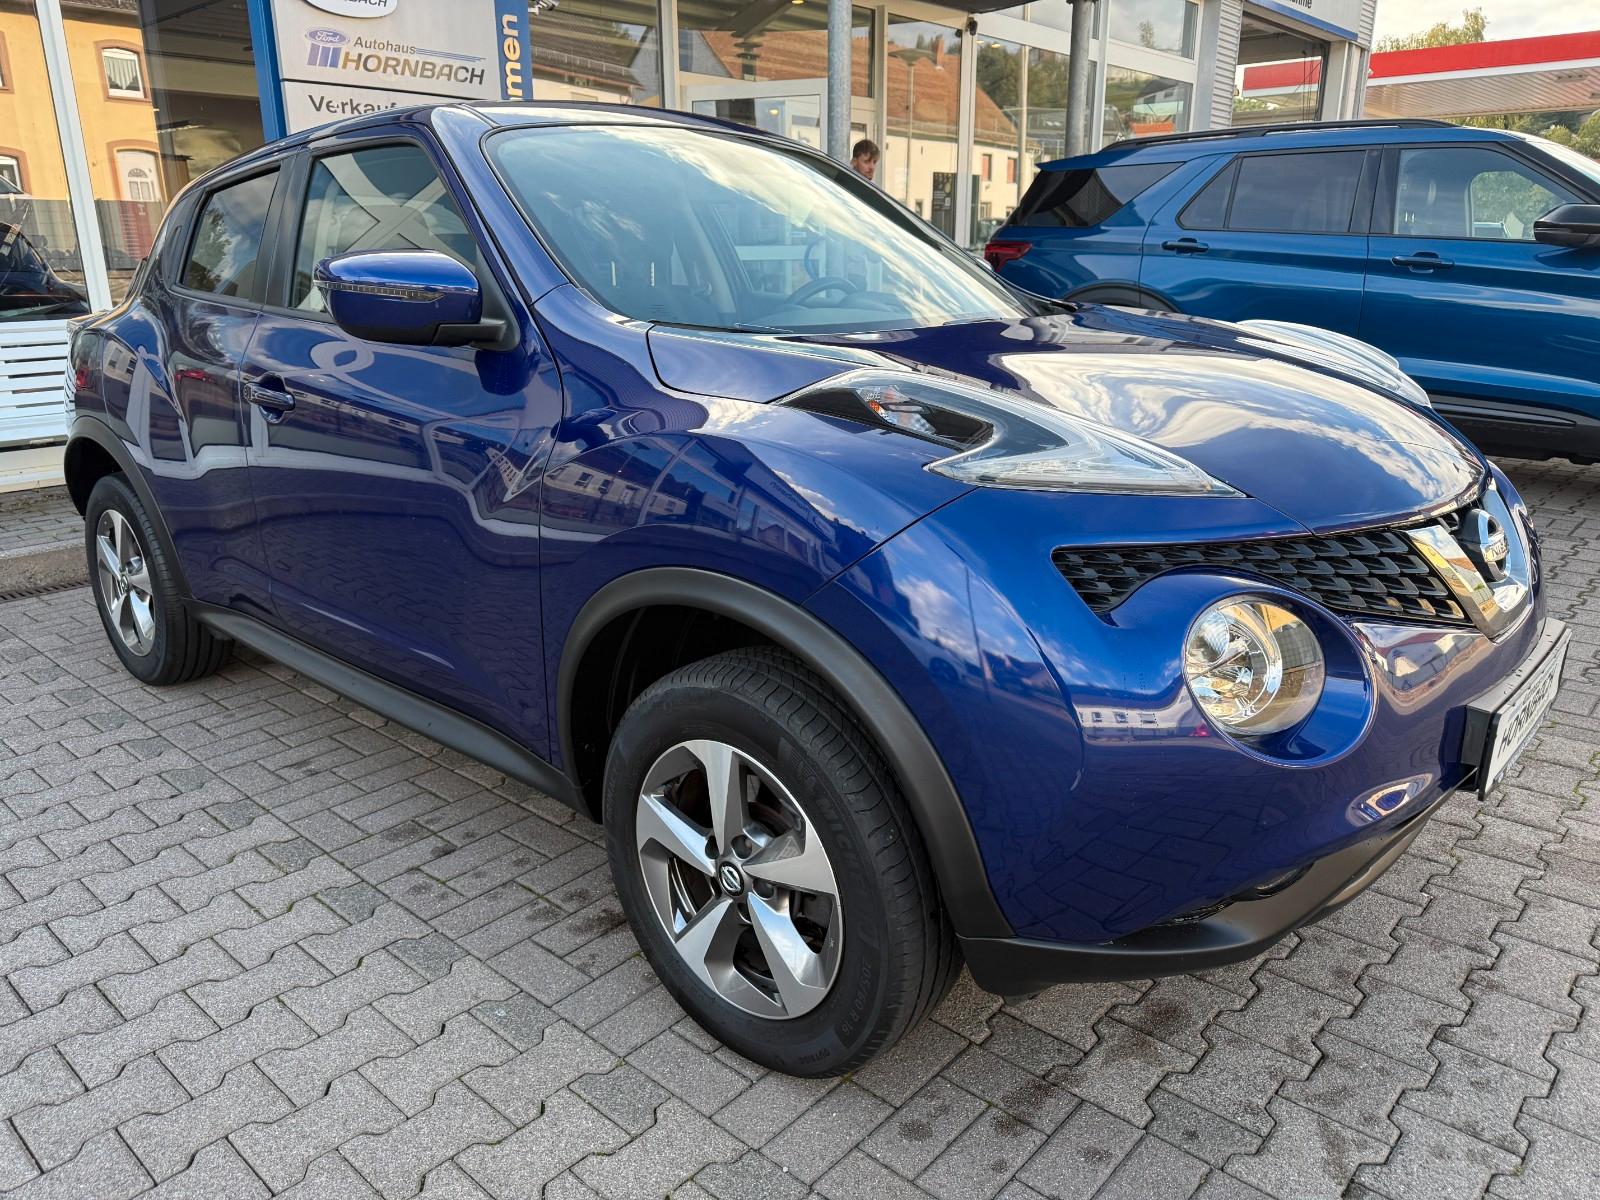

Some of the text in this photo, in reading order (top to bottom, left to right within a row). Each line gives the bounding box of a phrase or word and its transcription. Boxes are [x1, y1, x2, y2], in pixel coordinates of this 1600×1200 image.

[316, 31, 339, 42] Ford
[353, 36, 417, 55] Autohaus
[341, 51, 486, 85] HORNBACH
[502, 14, 523, 100] men
